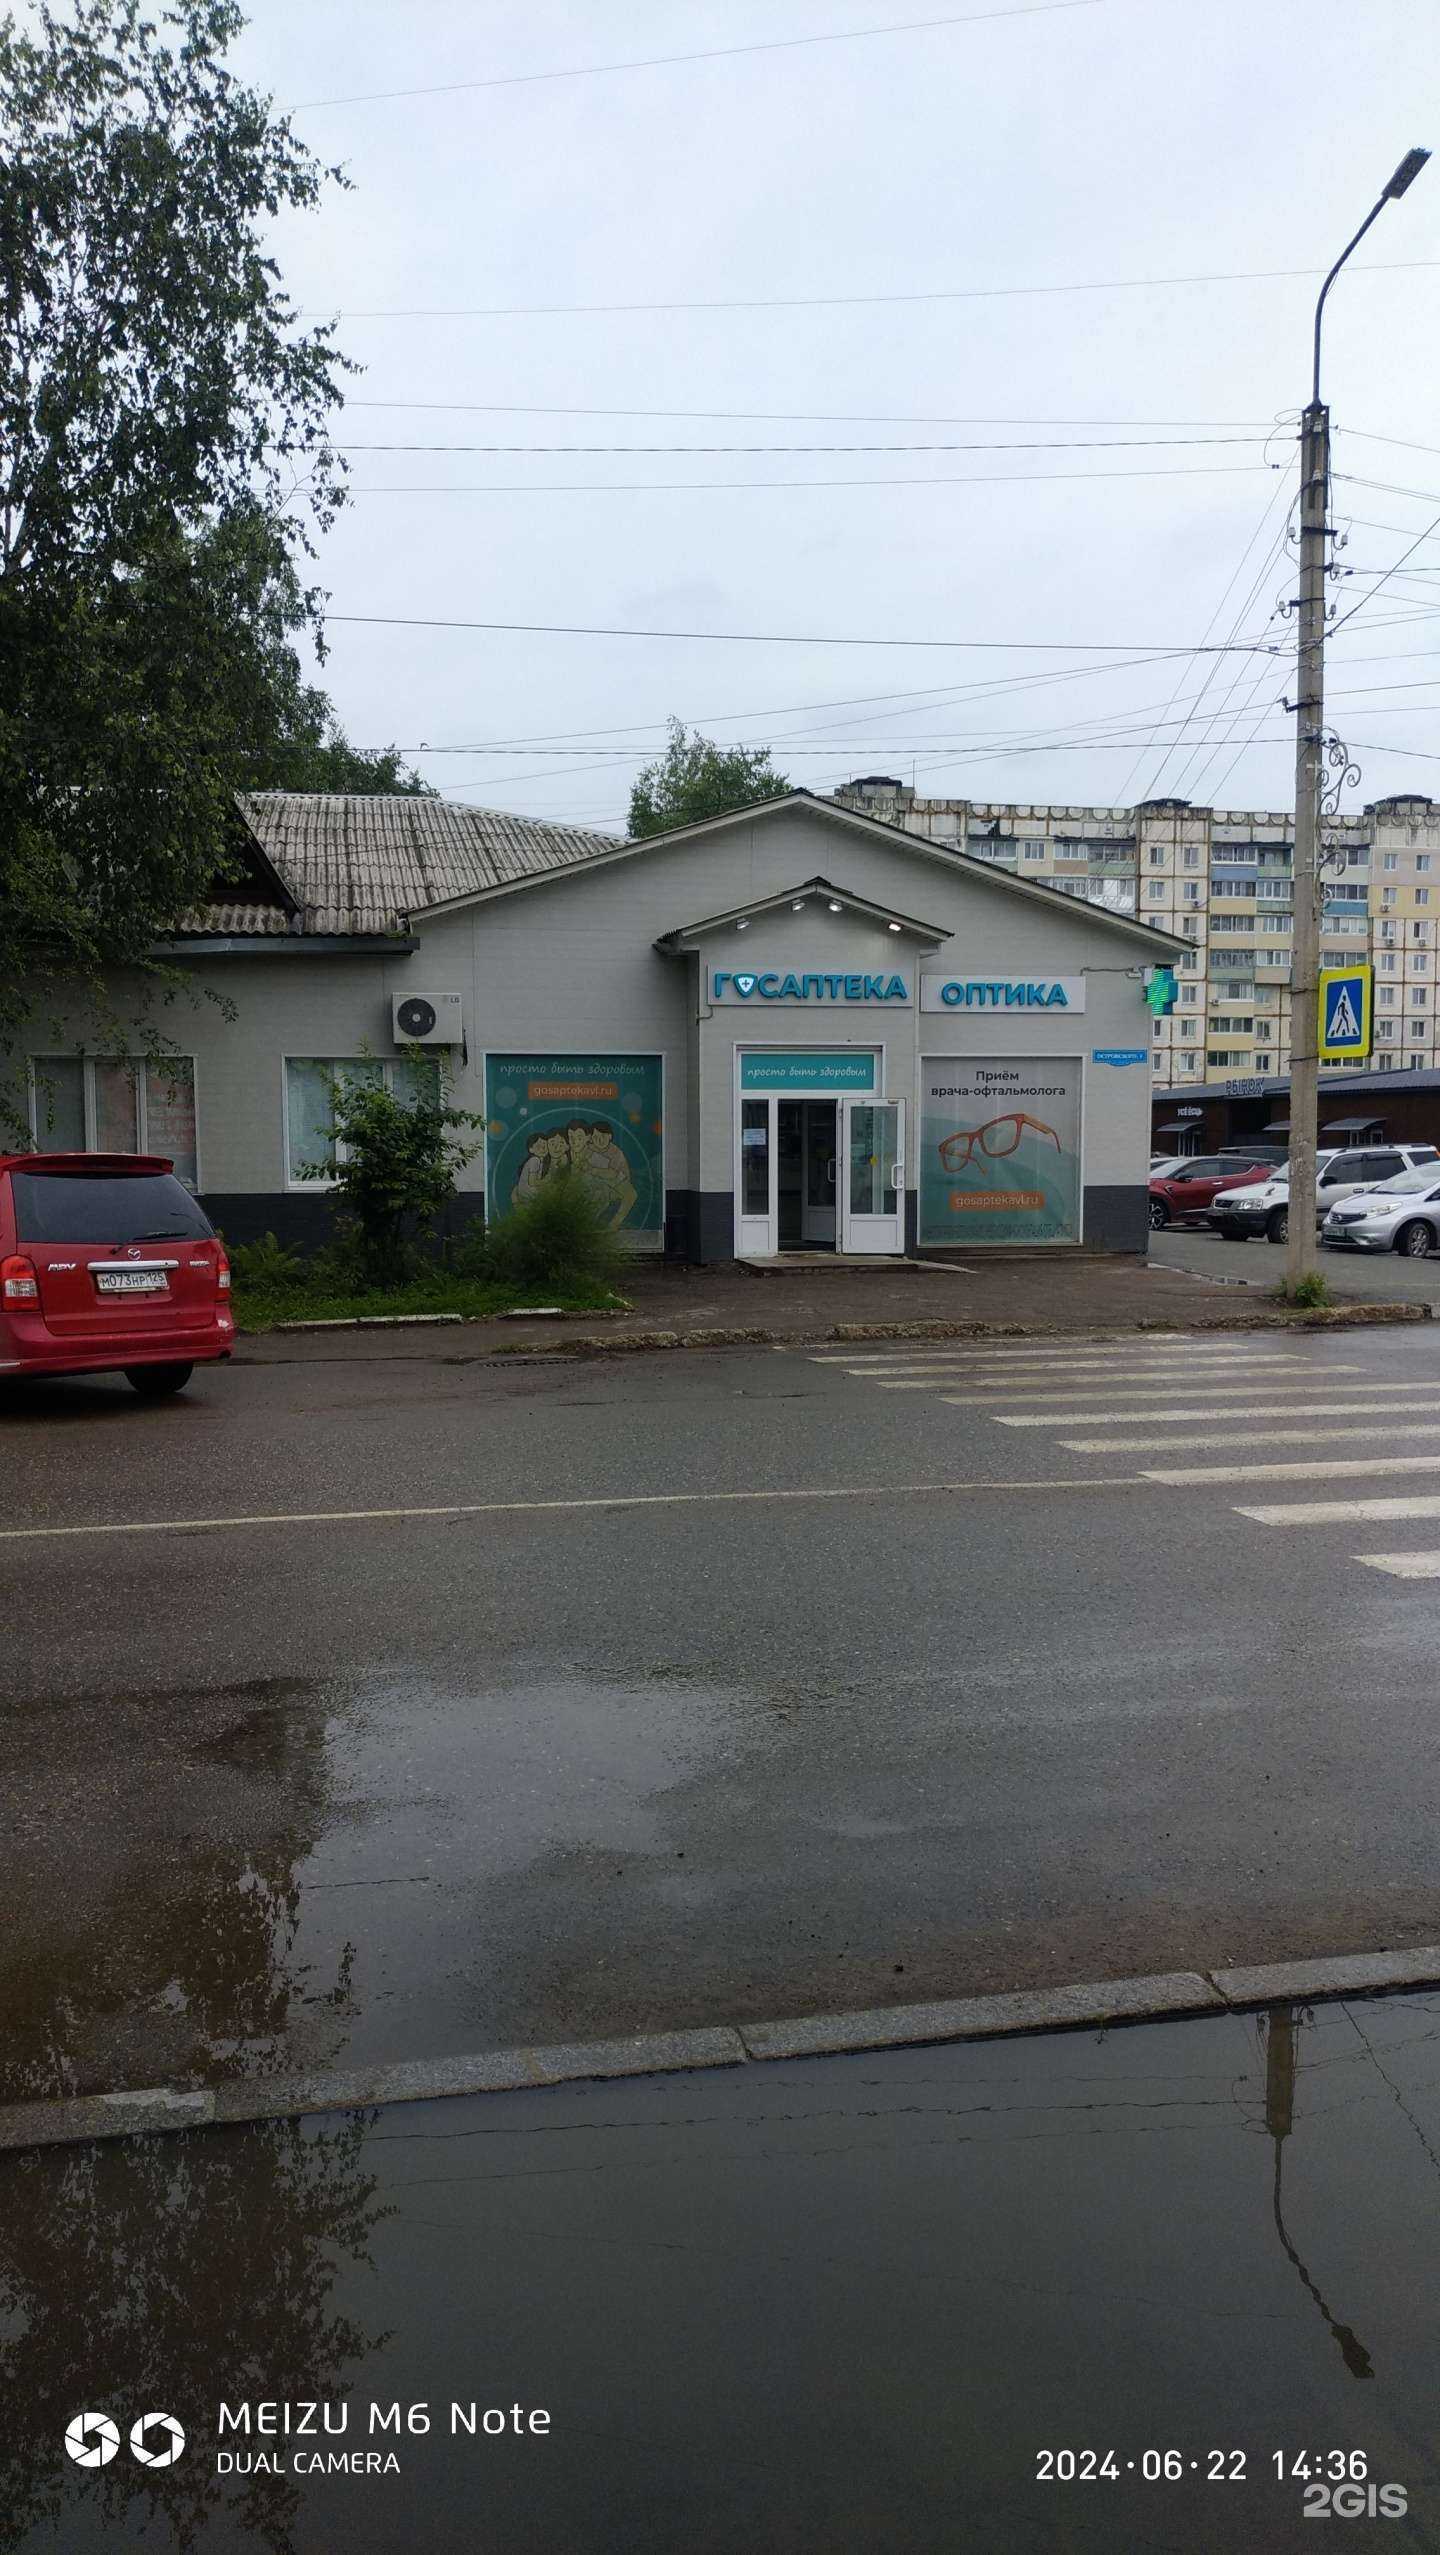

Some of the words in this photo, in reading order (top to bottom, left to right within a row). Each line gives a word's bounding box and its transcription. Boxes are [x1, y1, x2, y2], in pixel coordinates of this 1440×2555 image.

[941, 981, 1069, 1007] ОПТИКА
[500, 1063, 546, 1076] просто
[551, 1061, 583, 1074] быть
[587, 1062, 645, 1076] здоровым
[747, 1070, 786, 1079] просто
[789, 1066, 817, 1077] быть
[820, 1066, 866, 1079] здоровым
[976, 1070, 1019, 1083] Приём
[931, 1085, 1066, 1098] врача-офтальмолога
[1225, 1078, 1264, 1096] РЫНОК
[956, 1194, 1039, 1208] gosaptekavl.ru
